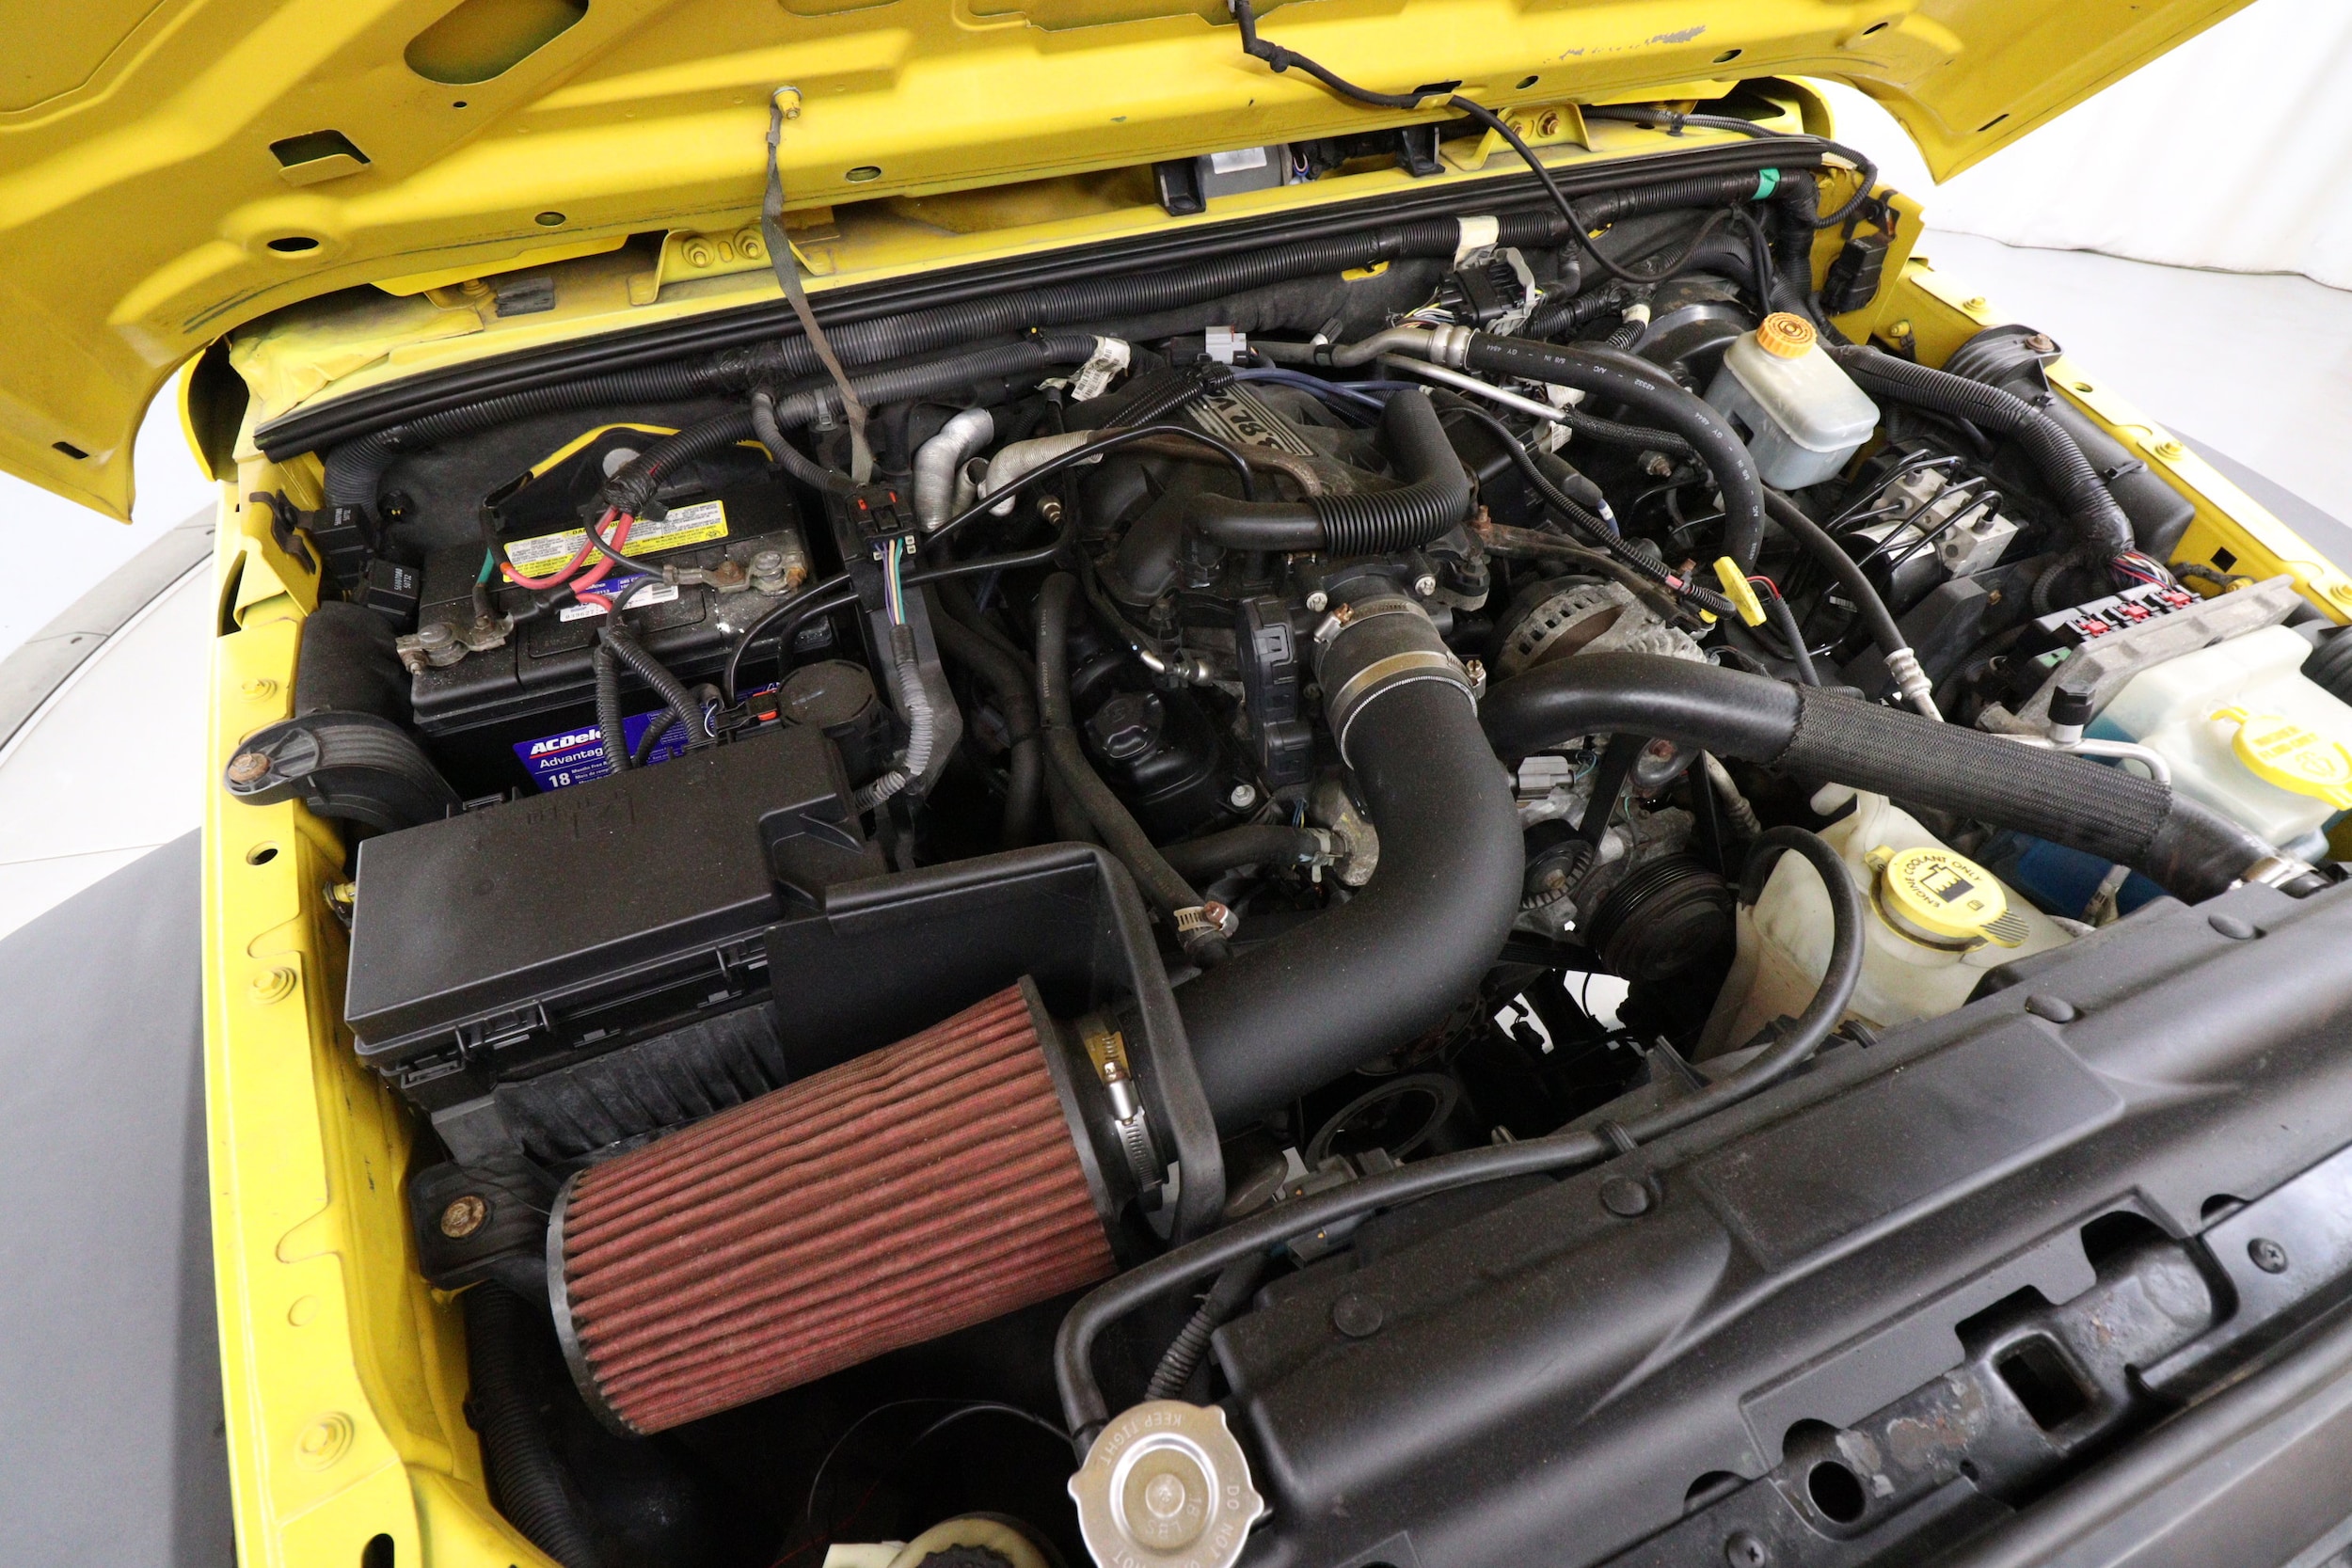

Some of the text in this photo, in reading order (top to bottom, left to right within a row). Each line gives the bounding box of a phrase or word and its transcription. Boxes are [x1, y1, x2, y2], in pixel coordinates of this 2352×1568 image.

[1593, 366, 1607, 374] A/C
[1712, 429, 1724, 438] GY
[531, 729, 602, 755] ACDelc
[540, 747, 604, 768] Advantag
[548, 772, 571, 788] 18
[1904, 855, 1983, 908] ENGINE COOLANT ONLY
[1099, 1412, 1182, 1465] KEEP TIGHT
[1227, 1485, 1240, 1510] DO
[1209, 1522, 1234, 1560] NOT
